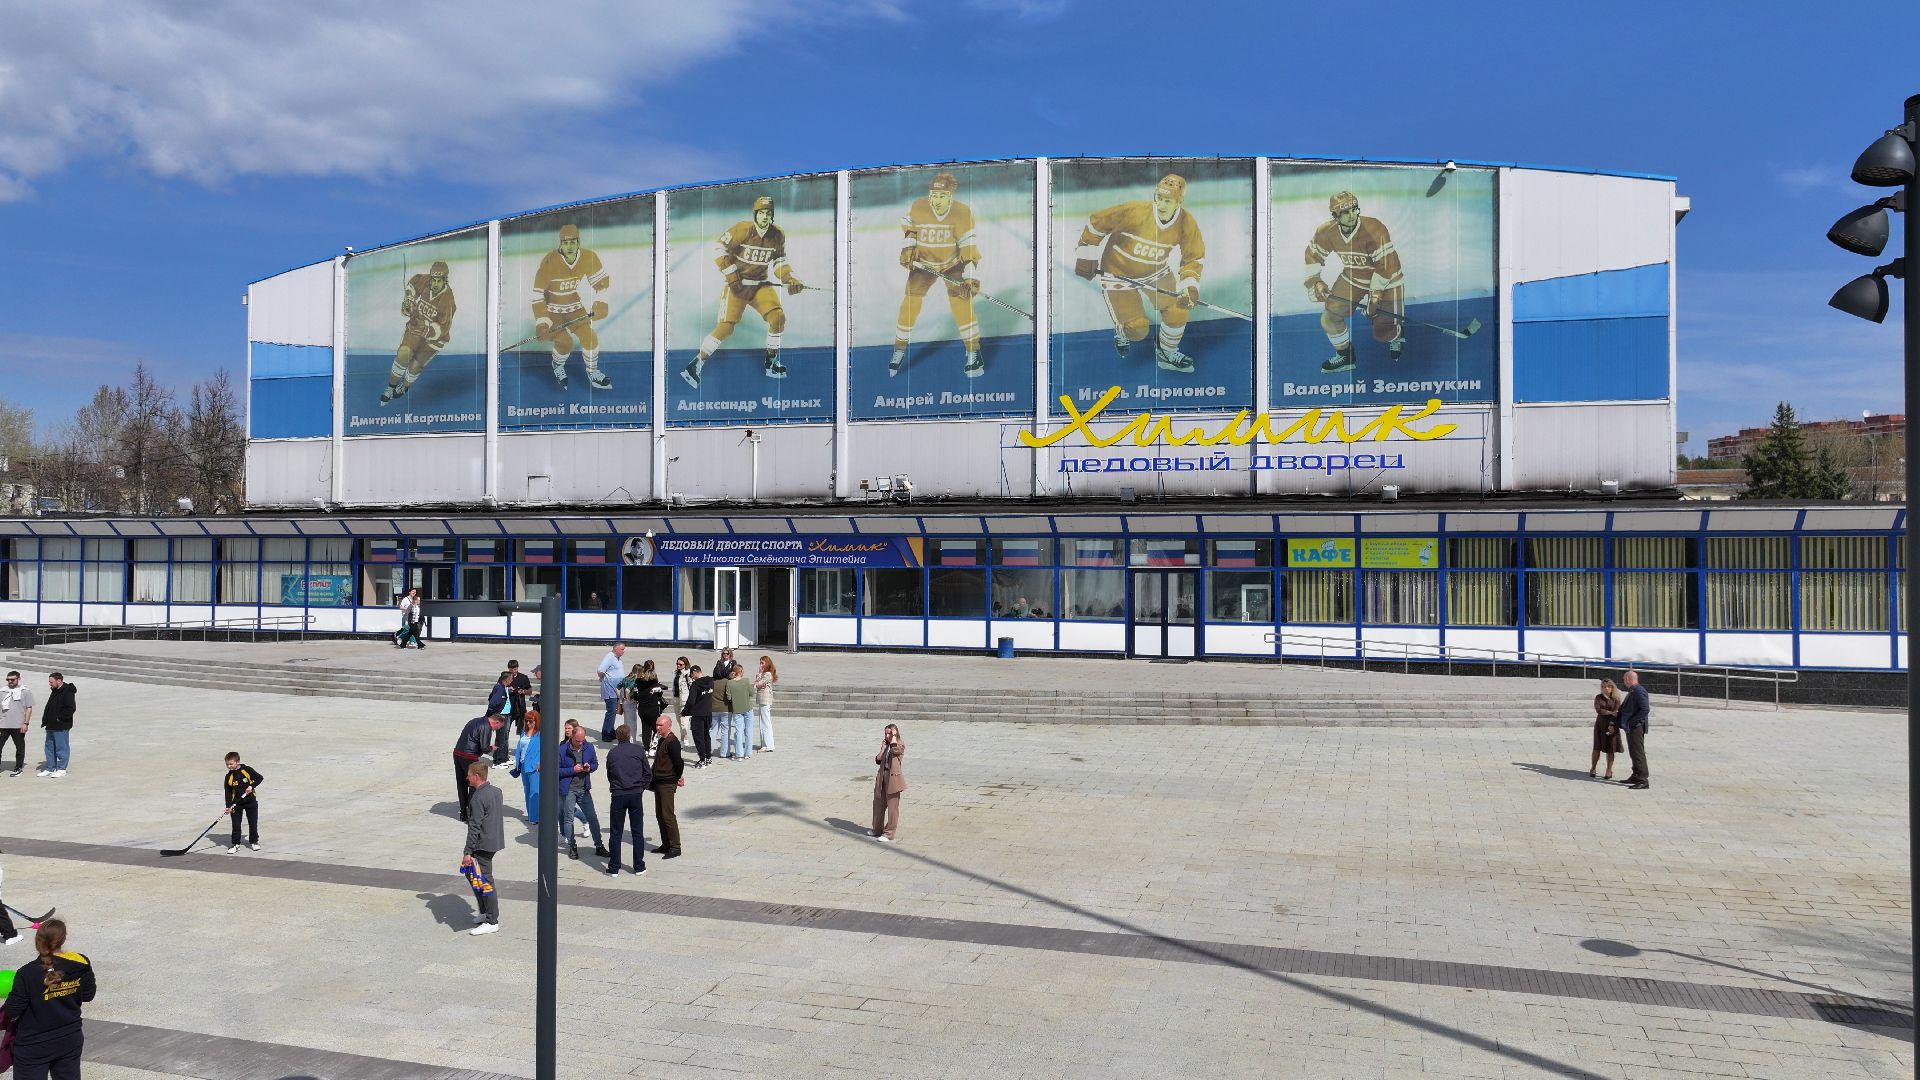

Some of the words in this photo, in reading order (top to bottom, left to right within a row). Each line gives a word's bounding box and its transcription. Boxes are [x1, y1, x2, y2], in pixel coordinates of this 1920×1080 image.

[920, 229, 951, 242] СССР
[743, 247, 772, 263] СССР
[1133, 242, 1165, 258] СССР
[1340, 254, 1367, 266] СССР
[417, 302, 438, 318] СССР
[1078, 388, 1129, 401] Игоь
[1135, 385, 1226, 401] Ларионов
[1283, 380, 1366, 397] Валерий
[1373, 379, 1481, 394] Зелепукин
[677, 399, 757, 413] Александр
[761, 397, 822, 411] Черных
[874, 393, 934, 409] Андрей
[940, 391, 1016, 405] Ломакин
[507, 403, 565, 418] Валерий
[569, 401, 647, 415] Каменский
[1019, 385, 1457, 448] Химик
[350, 414, 401, 427] Дмитрий
[404, 412, 482, 425] Квартальнов
[1057, 451, 1231, 474] ледовый
[1247, 452, 1407, 476] дворец
[660, 538, 715, 551] ЛЕДОВЫЙ
[715, 540, 761, 552] ДВОРЕЦ
[761, 540, 803, 550] СПОРТА
[684, 555, 700, 563] им.
[702, 553, 745, 563] Николая
[746, 554, 807, 564] Семёновича
[808, 554, 866, 564] Эпштейна
[1292, 548, 1352, 562] КАФЕ
